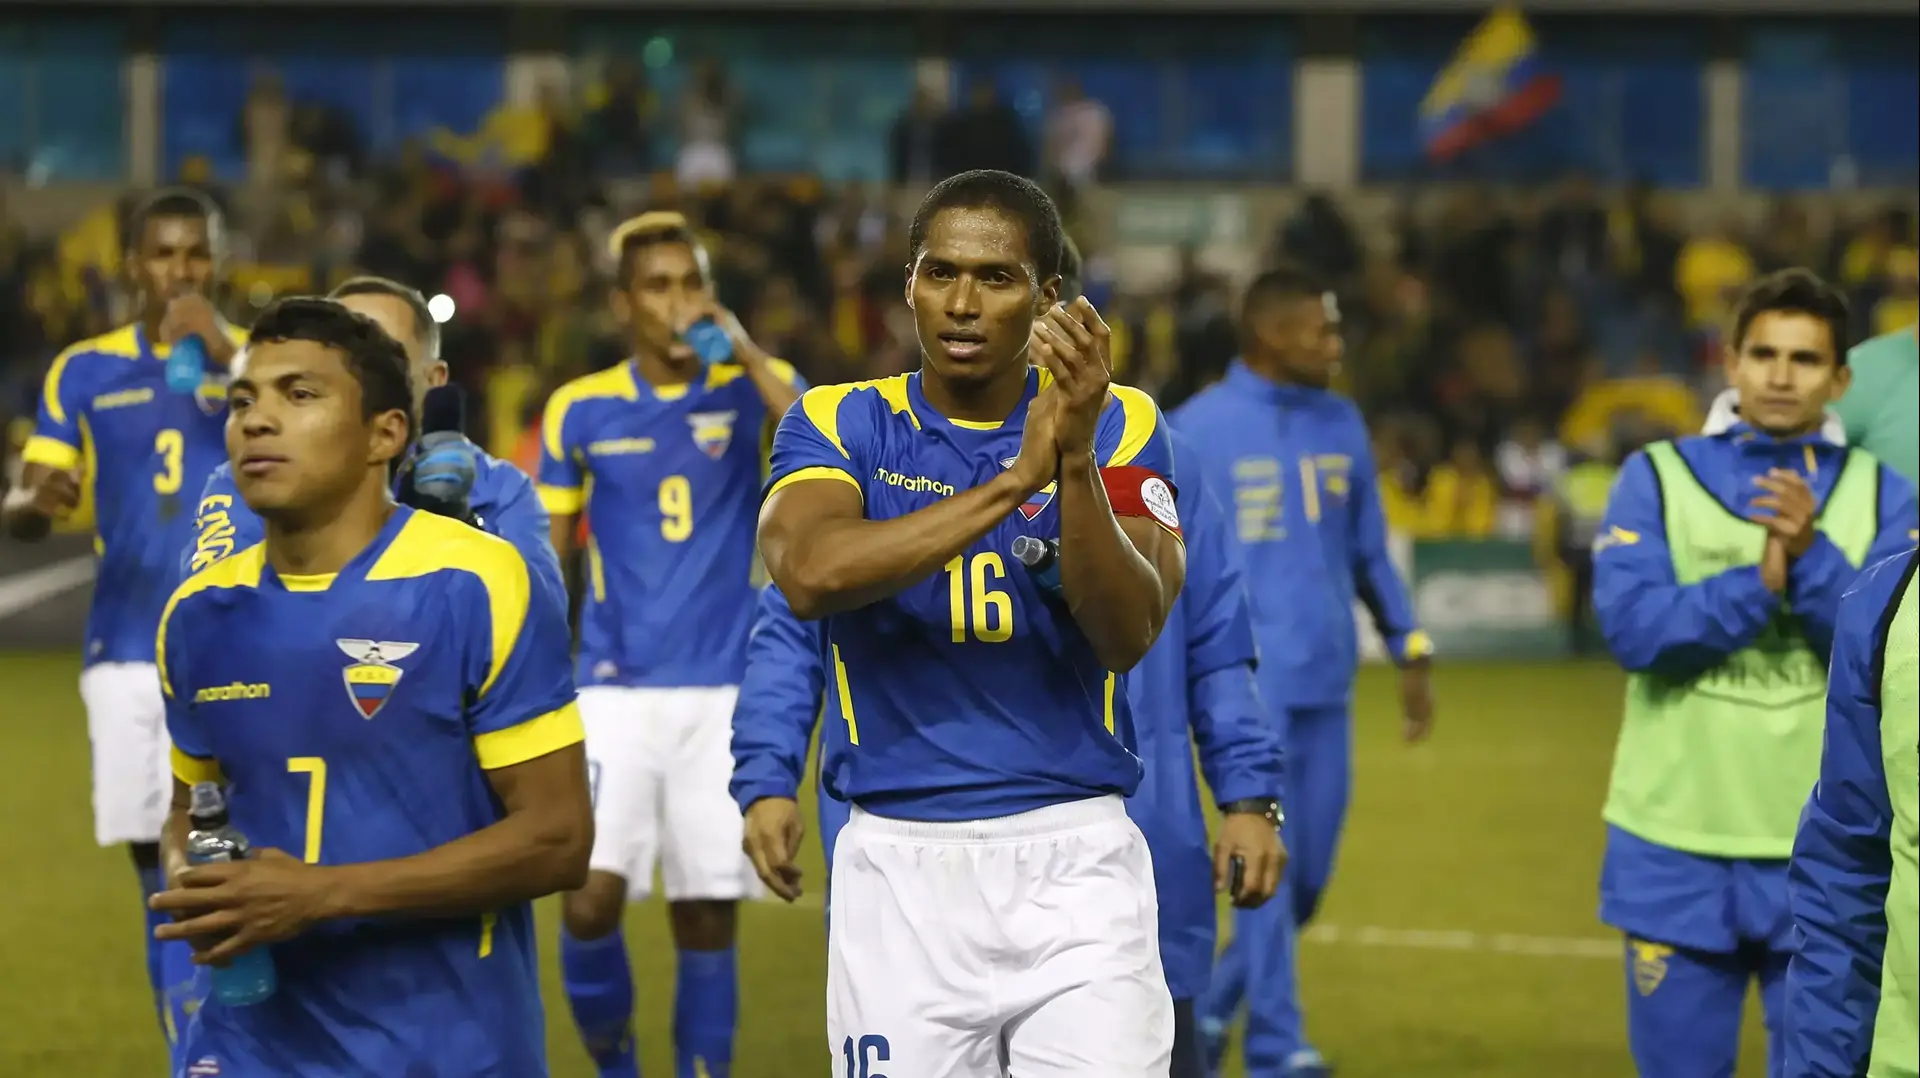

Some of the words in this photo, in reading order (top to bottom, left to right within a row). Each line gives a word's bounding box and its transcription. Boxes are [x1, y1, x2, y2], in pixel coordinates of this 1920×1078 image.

[153, 428, 184, 495] 3
[874, 467, 954, 497] marathon
[658, 474, 693, 543] 9
[944, 552, 1013, 643] 16
[287, 756, 327, 864] 7
[843, 1034, 891, 1078] 16
